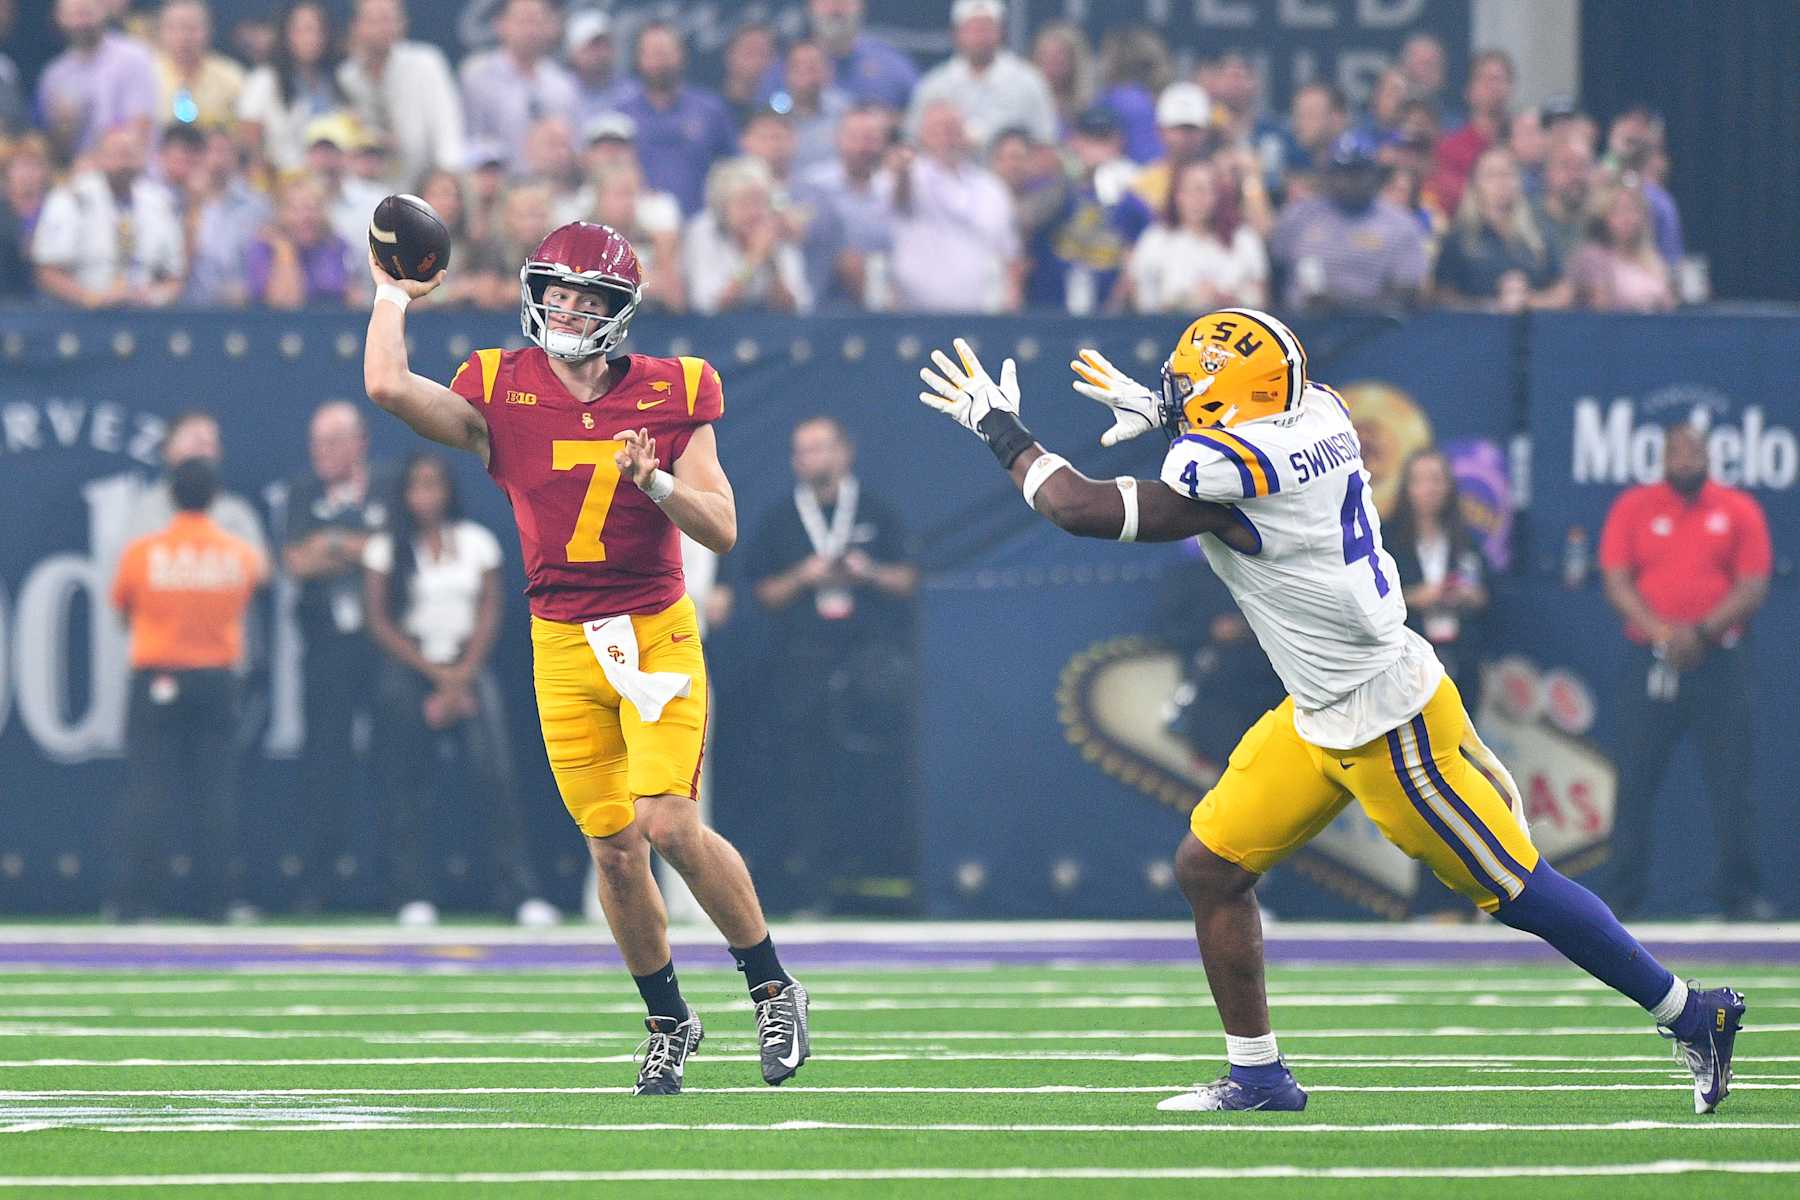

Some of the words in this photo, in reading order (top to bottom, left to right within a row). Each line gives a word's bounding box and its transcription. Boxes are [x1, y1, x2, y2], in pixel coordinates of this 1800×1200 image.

[1180, 460, 1199, 497] 4
[1573, 397, 1797, 490] Moelo
[552, 440, 627, 562] 7
[1340, 470, 1390, 598] 4
[607, 645, 626, 665] SC
